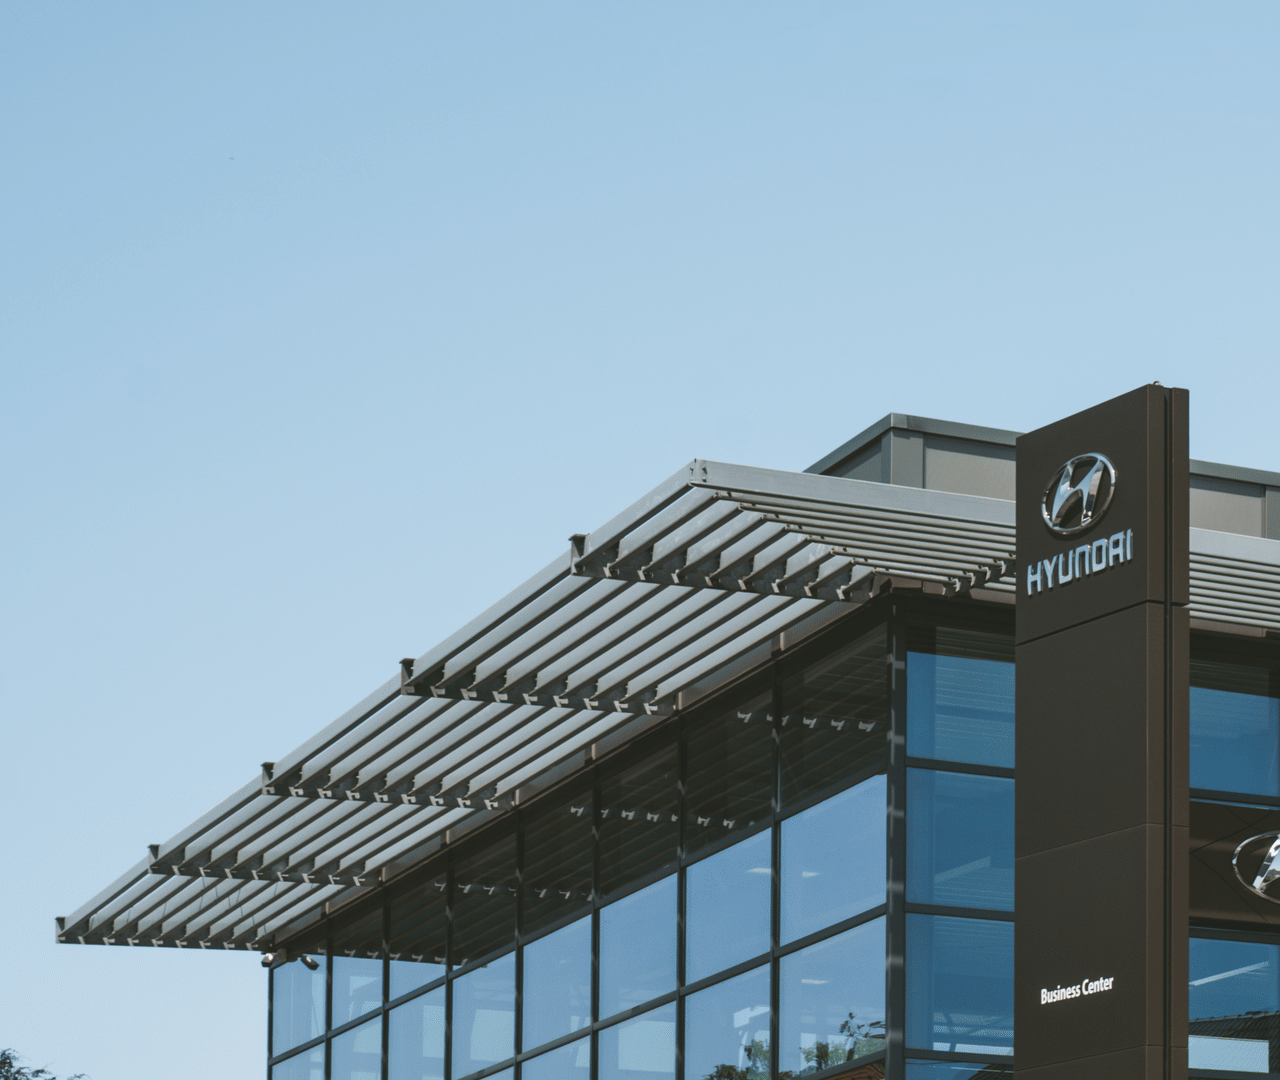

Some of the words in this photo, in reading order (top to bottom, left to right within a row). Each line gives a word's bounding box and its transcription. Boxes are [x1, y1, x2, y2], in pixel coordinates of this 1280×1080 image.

[1027, 528, 1133, 596] HYUNDAI
[1040, 984, 1081, 1005] Business
[1082, 976, 1114, 996] Center
